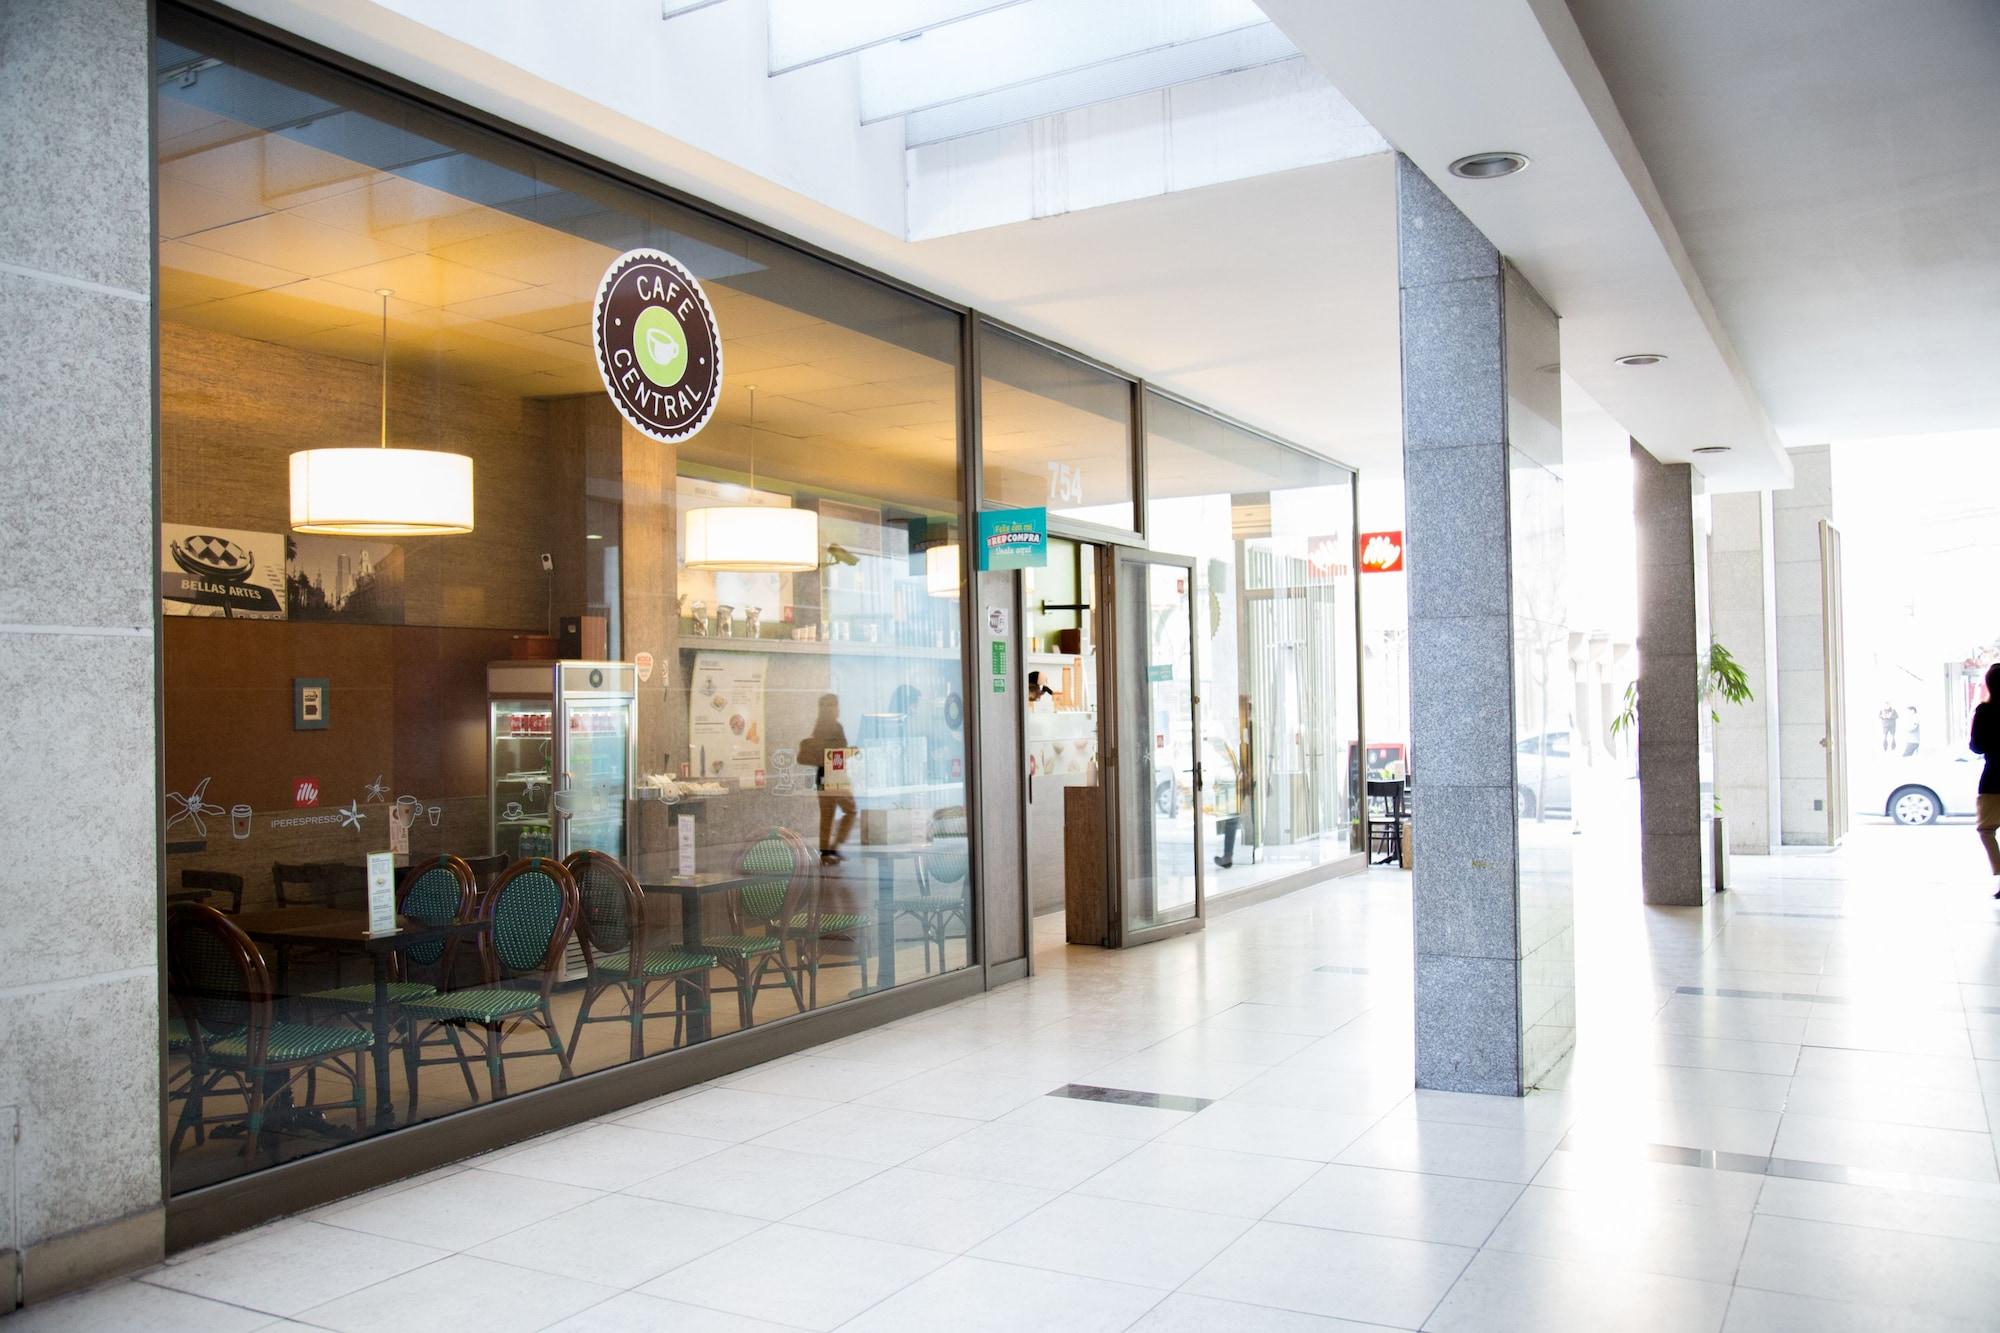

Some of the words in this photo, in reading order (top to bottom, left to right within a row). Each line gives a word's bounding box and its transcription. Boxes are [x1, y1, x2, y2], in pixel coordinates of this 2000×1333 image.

[636, 275, 694, 322] CAFE
[614, 348, 702, 419] CENTRAL
[1047, 461, 1083, 504] 754
[180, 578, 226, 595] BELLAS
[228, 582, 262, 600] ARTES
[296, 783, 320, 805] illy
[271, 814, 344, 829] IPERESPRESSO
